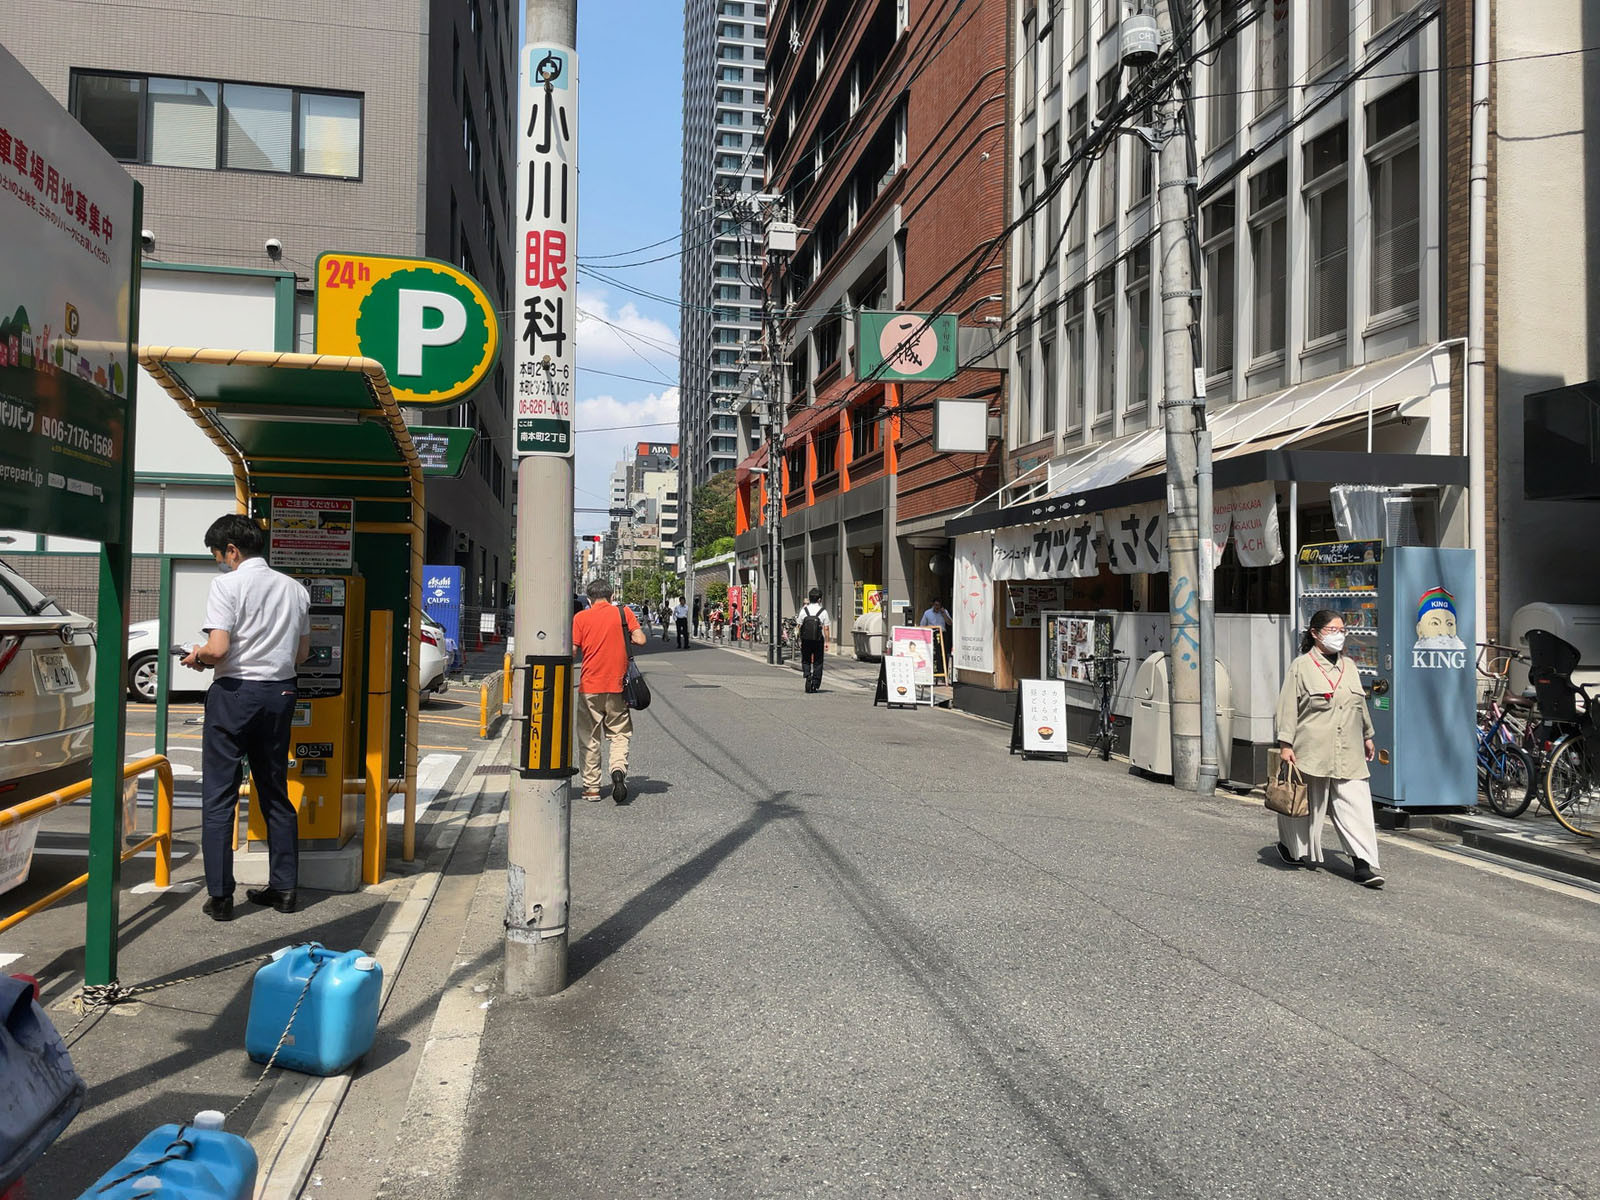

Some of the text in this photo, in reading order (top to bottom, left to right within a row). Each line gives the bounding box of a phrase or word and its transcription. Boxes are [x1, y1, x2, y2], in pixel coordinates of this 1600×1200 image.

[523, 92, 570, 357] 小川眼科
[397, 288, 467, 377] P
[519, 361, 570, 379] 本町23-6
[518, 399, 569, 416] 06-6261-0413
[50, 417, 113, 458] 06-7176-1568
[520, 432, 567, 443] 南本町2丁目
[651, 446, 669, 454] APA
[427, 576, 451, 586] Asahi
[427, 597, 450, 605] CALPIS
[1411, 650, 1467, 669] KING
